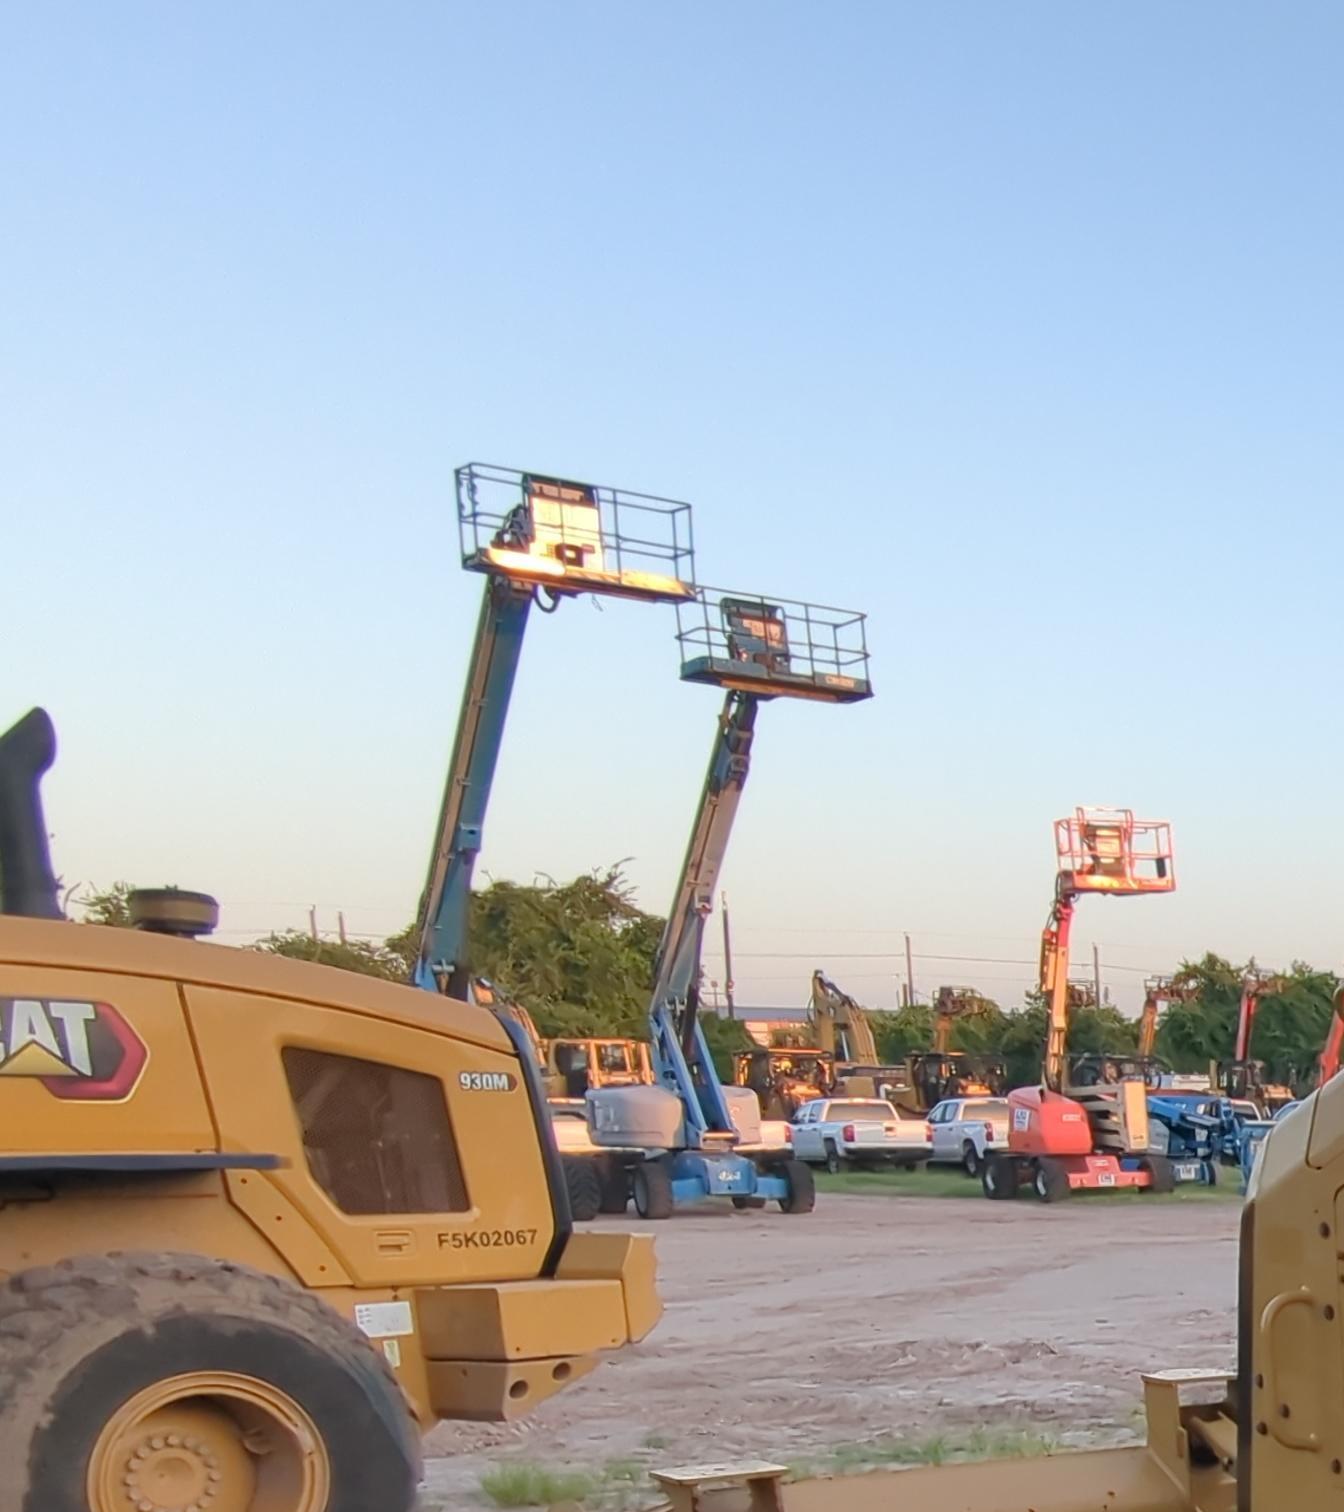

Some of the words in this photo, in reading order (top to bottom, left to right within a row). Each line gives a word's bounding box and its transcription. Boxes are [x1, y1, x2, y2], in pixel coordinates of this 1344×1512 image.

[0, 1000, 96, 1077] AT
[459, 1072, 509, 1091] 930M
[437, 1228, 538, 1249] F5K02067
